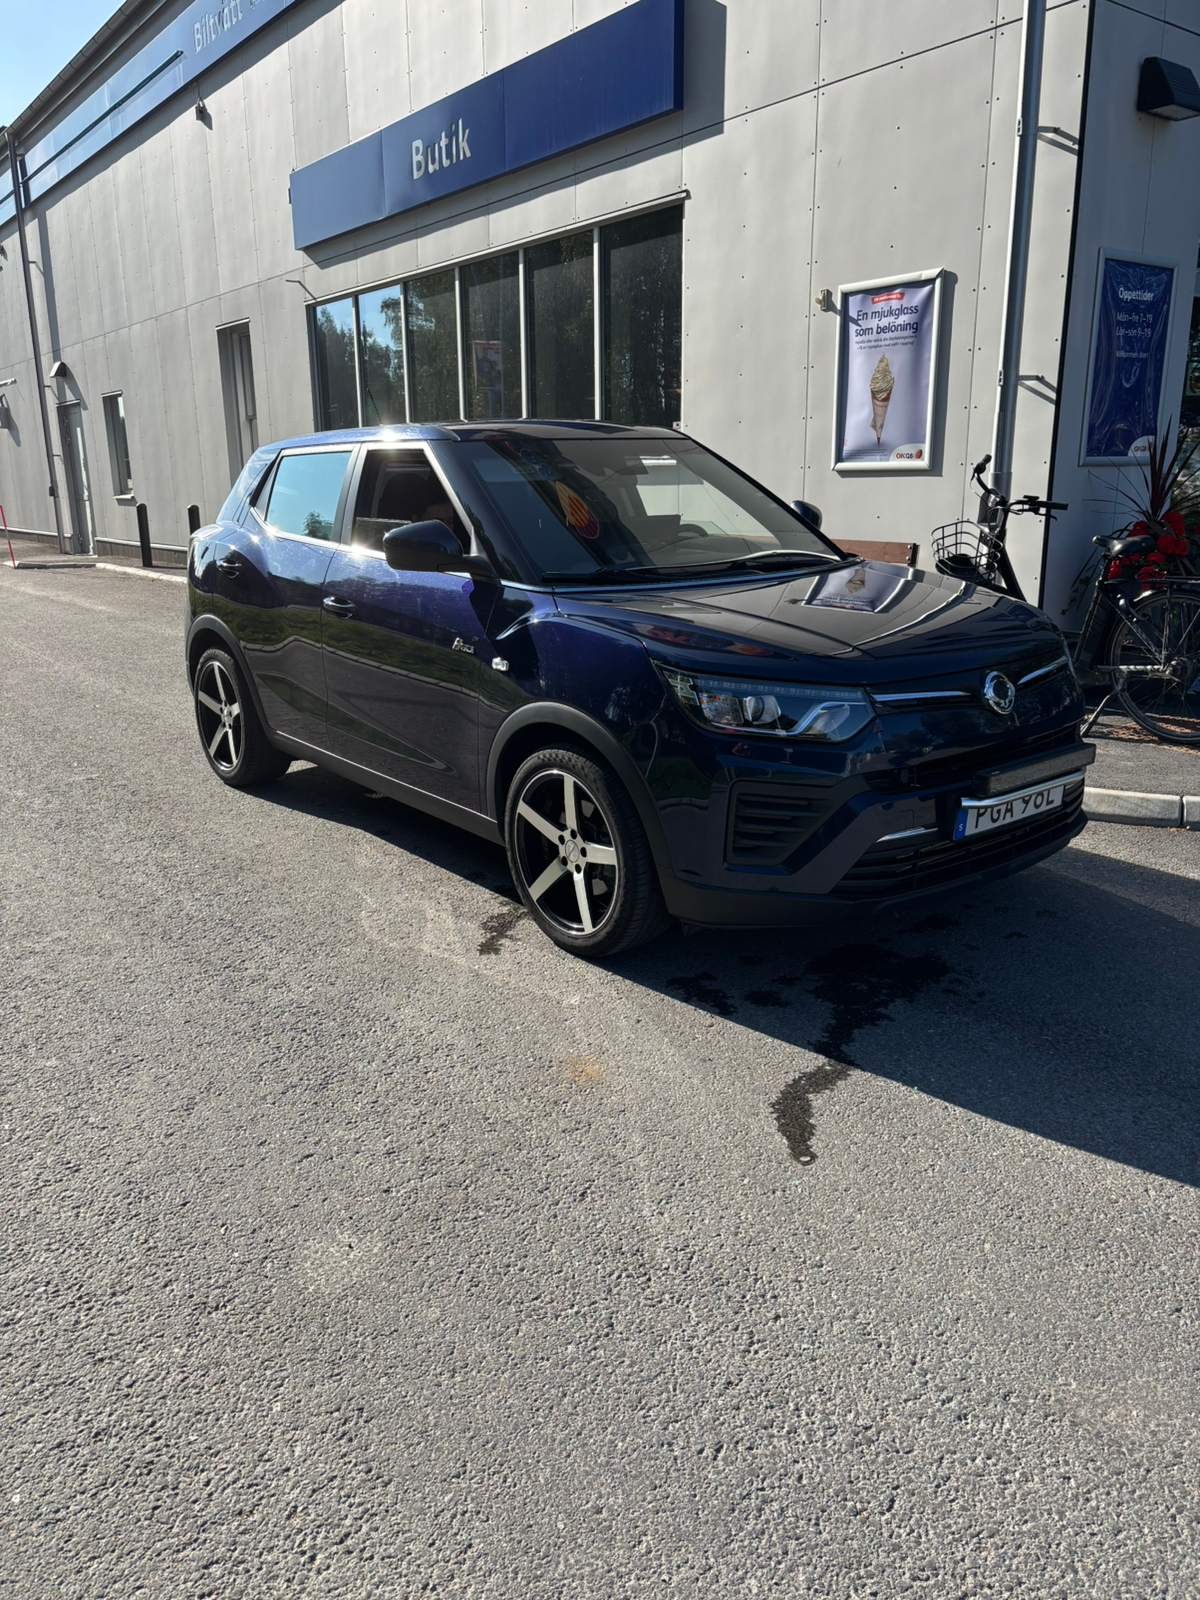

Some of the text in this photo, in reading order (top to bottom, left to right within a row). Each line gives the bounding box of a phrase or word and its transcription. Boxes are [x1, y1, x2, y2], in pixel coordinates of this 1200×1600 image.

[411, 117, 472, 180] Butik
[1118, 284, 1154, 302] Öppettider
[856, 303, 919, 322] En mjukglass
[854, 320, 919, 338] som belöning
[975, 800, 1014, 829] PGA
[958, 823, 964, 832] S
